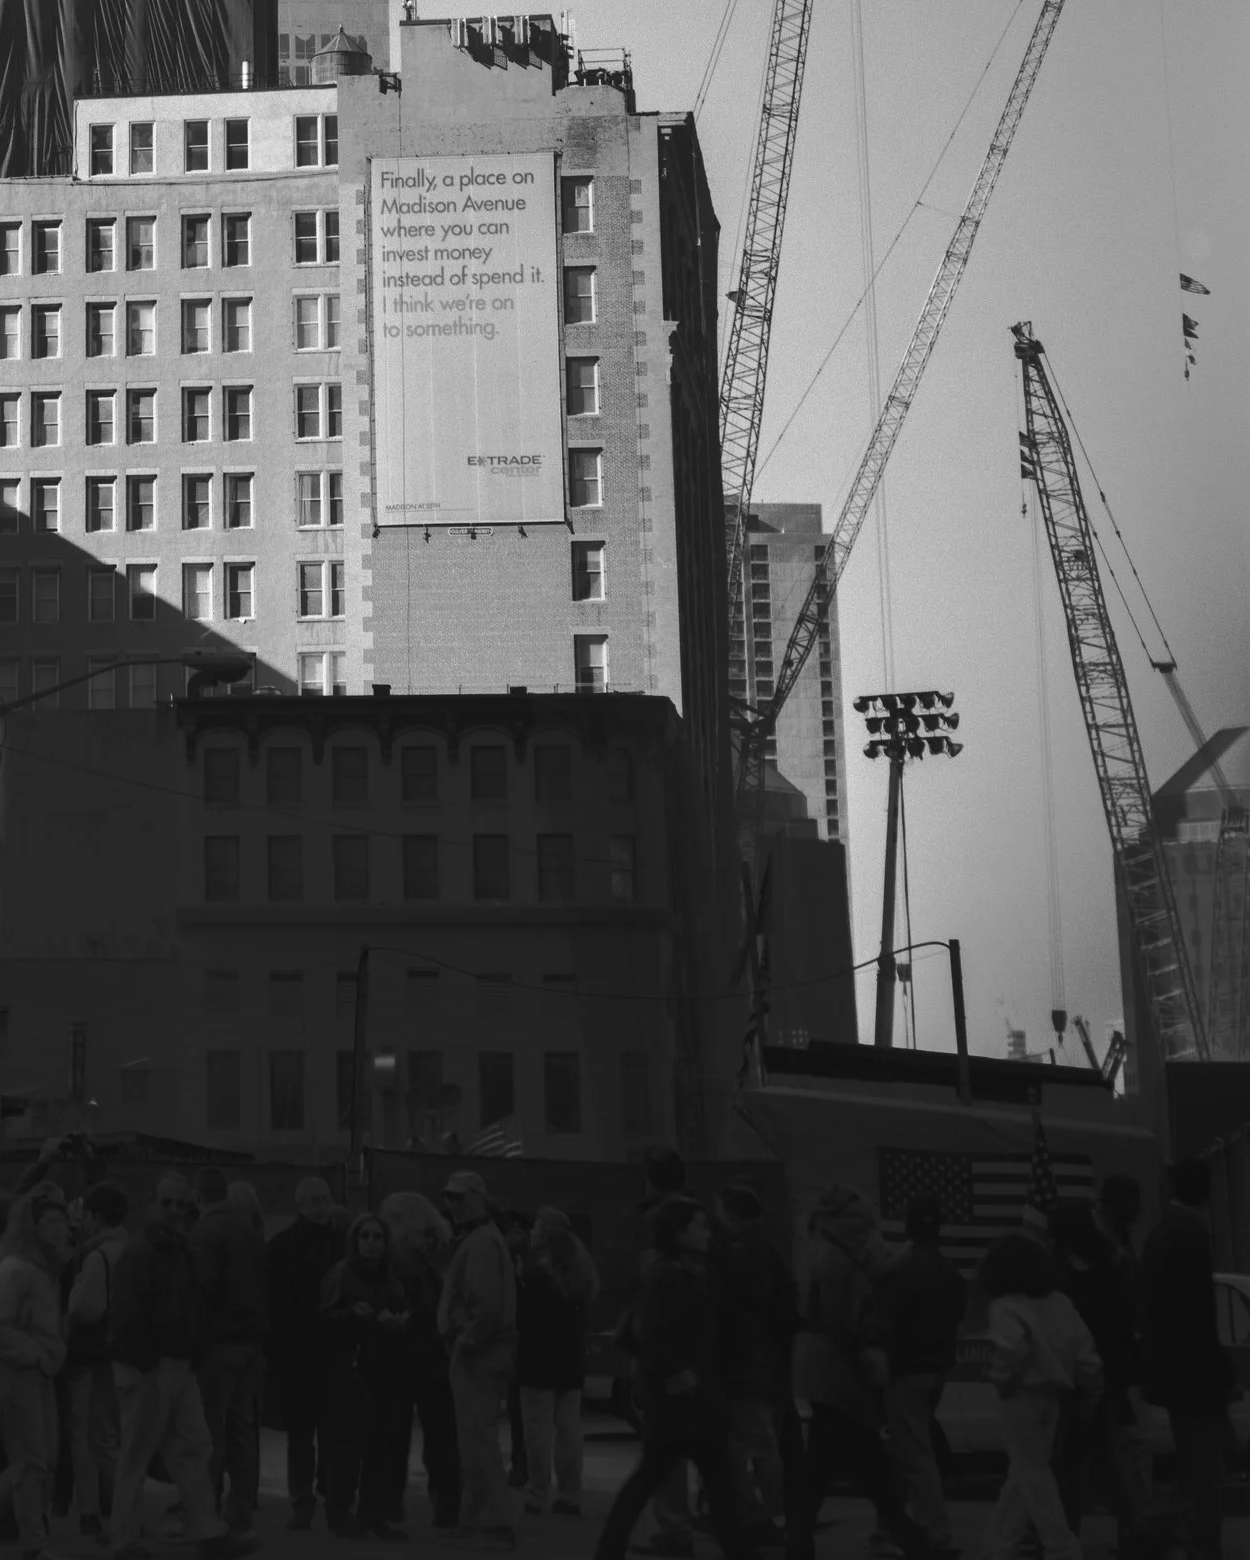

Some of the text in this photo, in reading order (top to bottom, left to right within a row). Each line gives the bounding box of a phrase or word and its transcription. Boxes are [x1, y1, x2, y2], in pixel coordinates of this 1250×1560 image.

[381, 166, 534, 192] Finally, a place on
[381, 194, 526, 214] Madison Avenue
[381, 218, 509, 241] where you can
[382, 245, 493, 264] invest money
[382, 263, 544, 289] instead of spend it.
[382, 292, 514, 313] I think we're on
[383, 315, 499, 340] to something.
[491, 466, 542, 475] center
